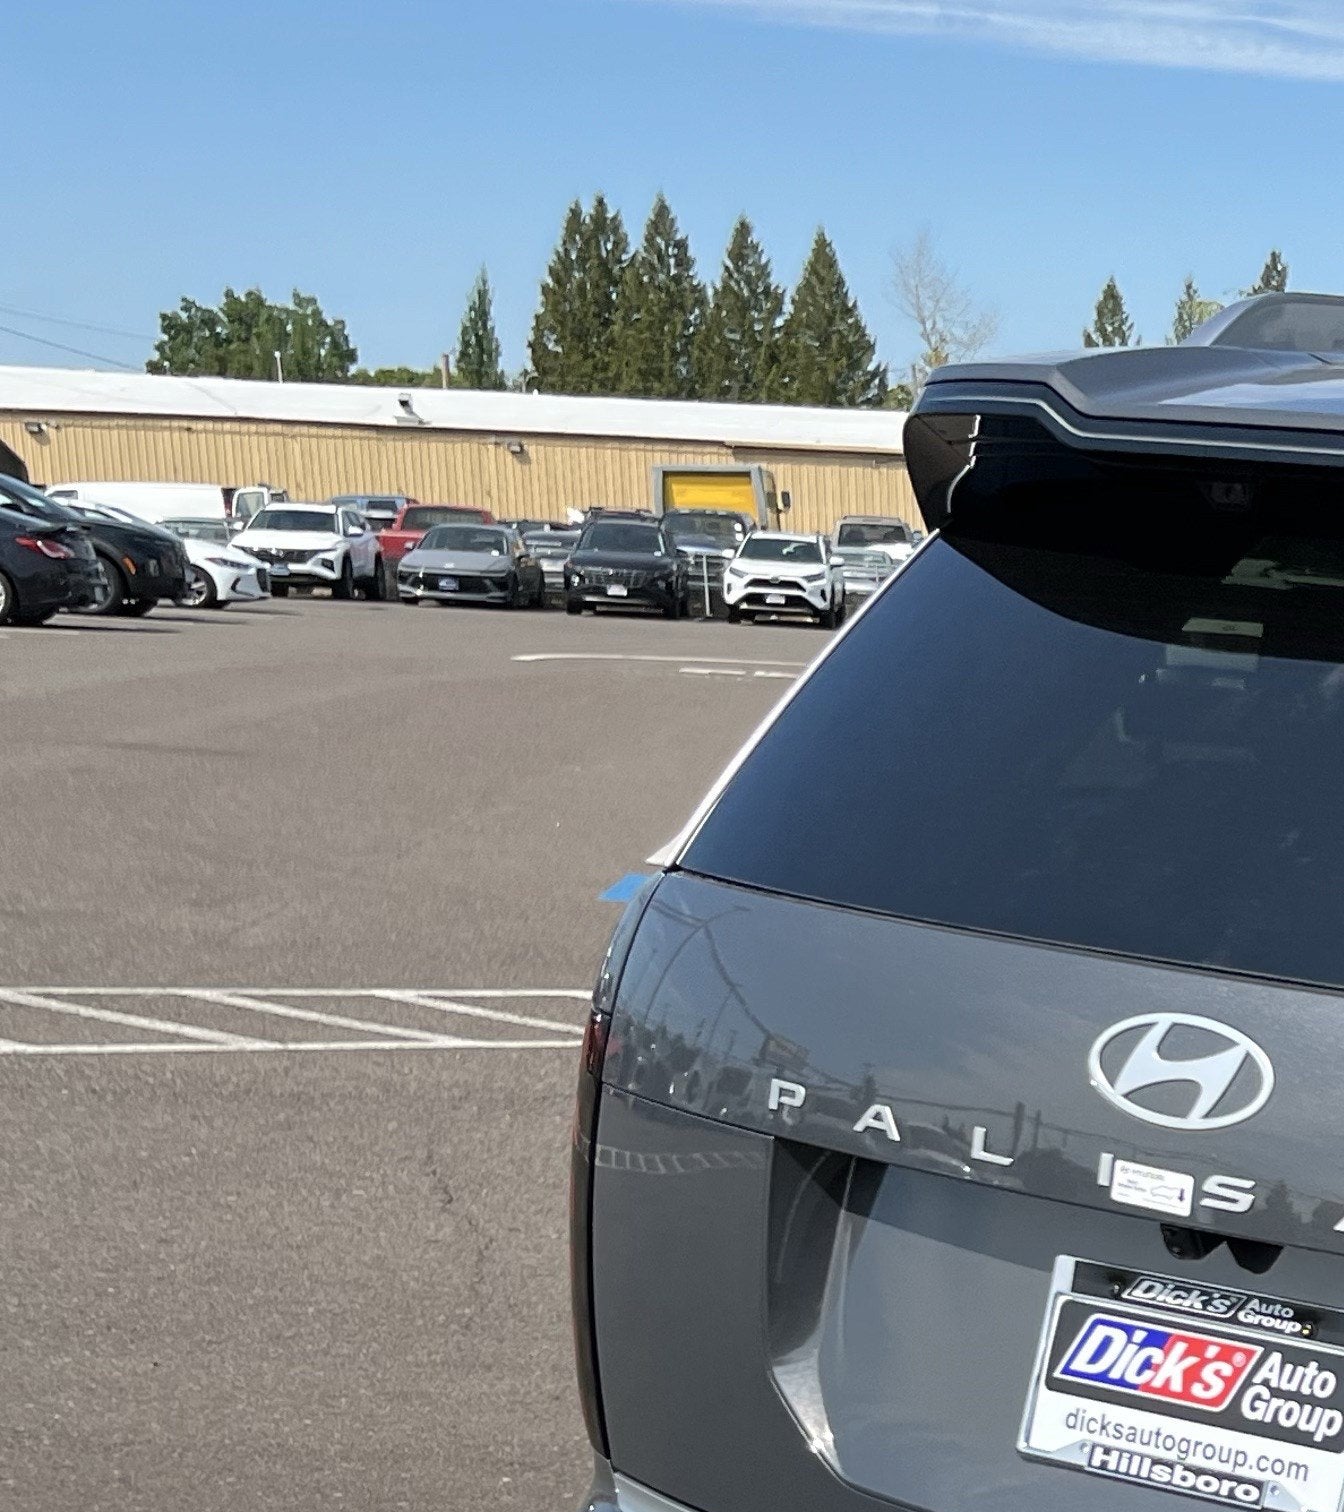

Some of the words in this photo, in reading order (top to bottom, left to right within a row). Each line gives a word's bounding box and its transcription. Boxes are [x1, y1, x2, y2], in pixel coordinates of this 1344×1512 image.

[1134, 1278, 1233, 1315] Dick's
[1237, 1309, 1302, 1335] Group
[1248, 1298, 1294, 1319] Auto
[1067, 1328, 1235, 1402] Dick's
[1252, 1352, 1337, 1400] Auto
[1241, 1388, 1344, 1442] Group
[1065, 1407, 1310, 1483] dicksautogroup.com
[1090, 1445, 1262, 1503] Hillsboro
